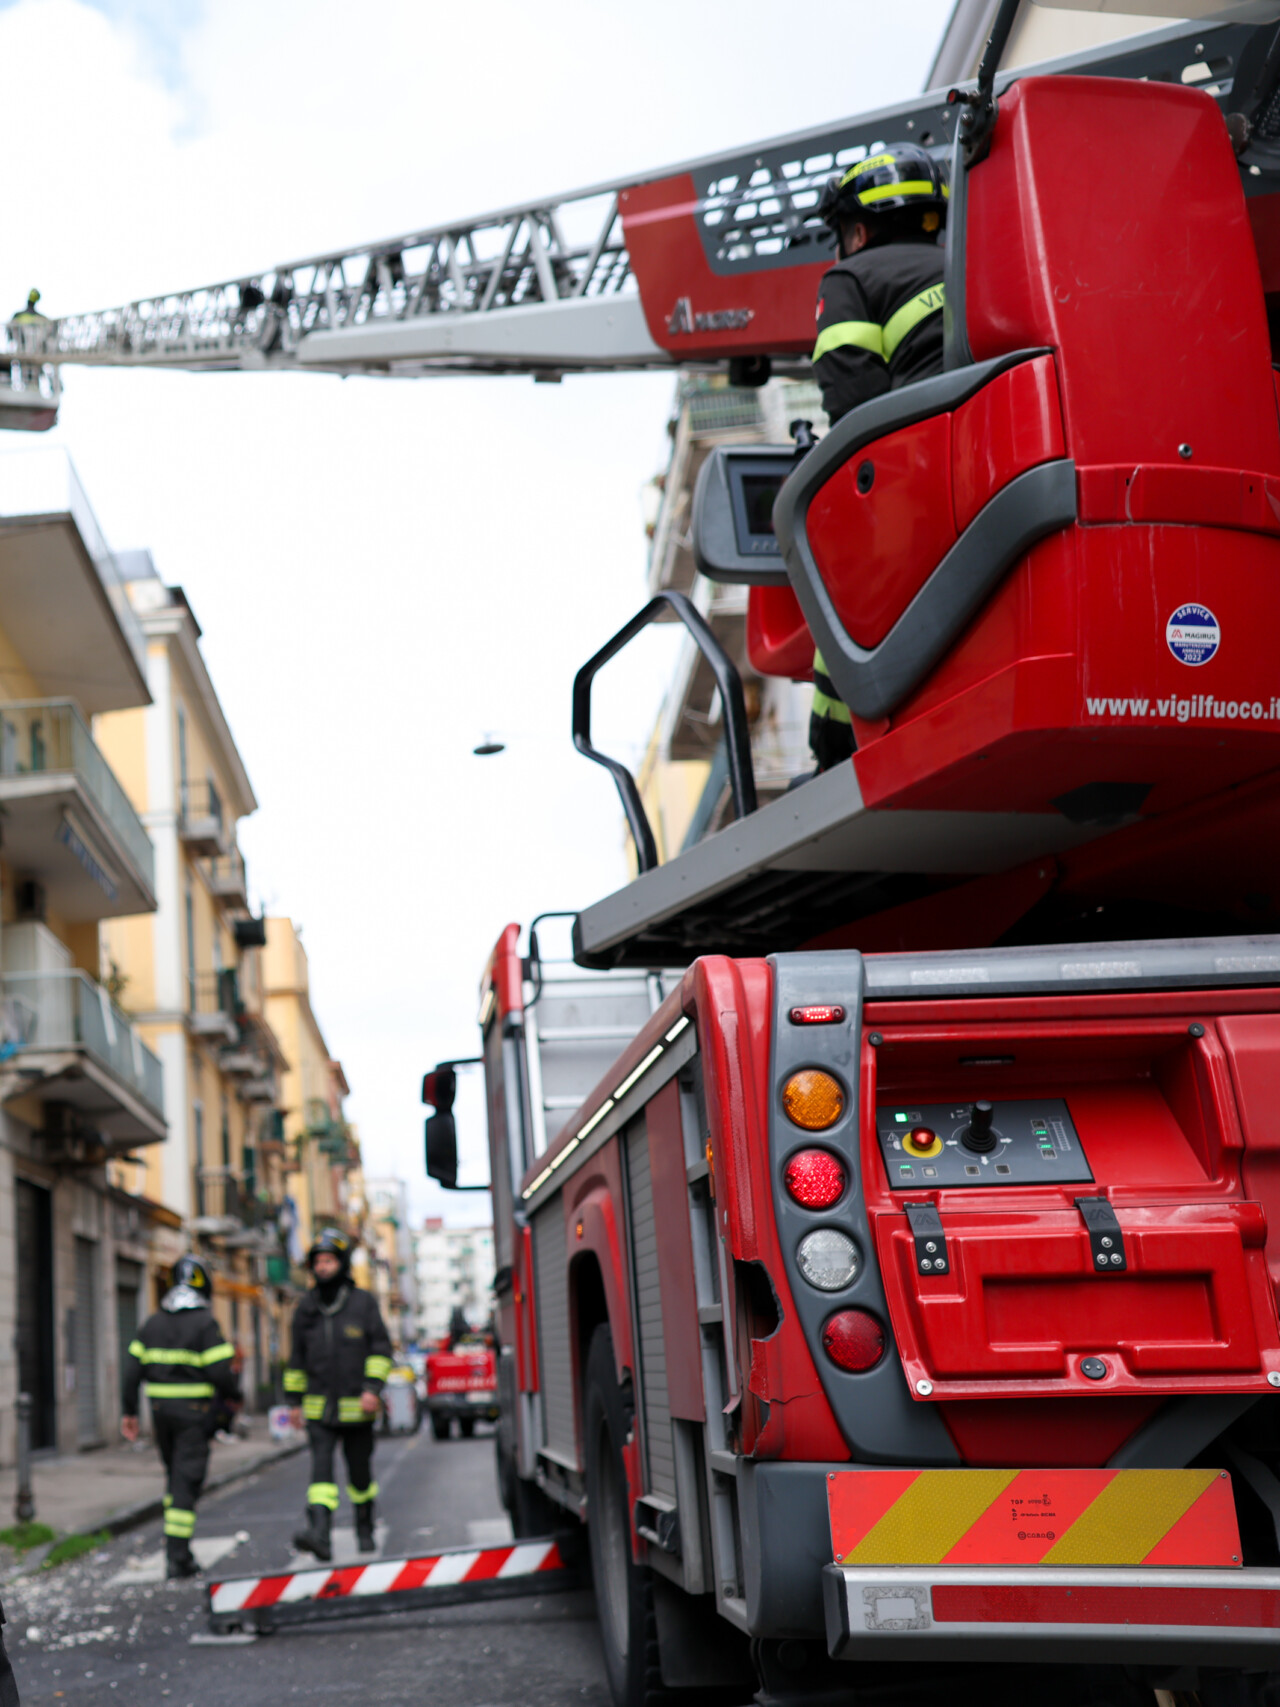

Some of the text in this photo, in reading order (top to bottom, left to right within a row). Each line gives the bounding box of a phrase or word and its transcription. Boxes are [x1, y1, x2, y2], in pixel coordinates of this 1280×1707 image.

[919, 288, 945, 308] VI
[1177, 606, 1210, 621] SERVICE
[1184, 632, 1216, 640] MAGIRUS
[1184, 654, 1202, 662] 2022
